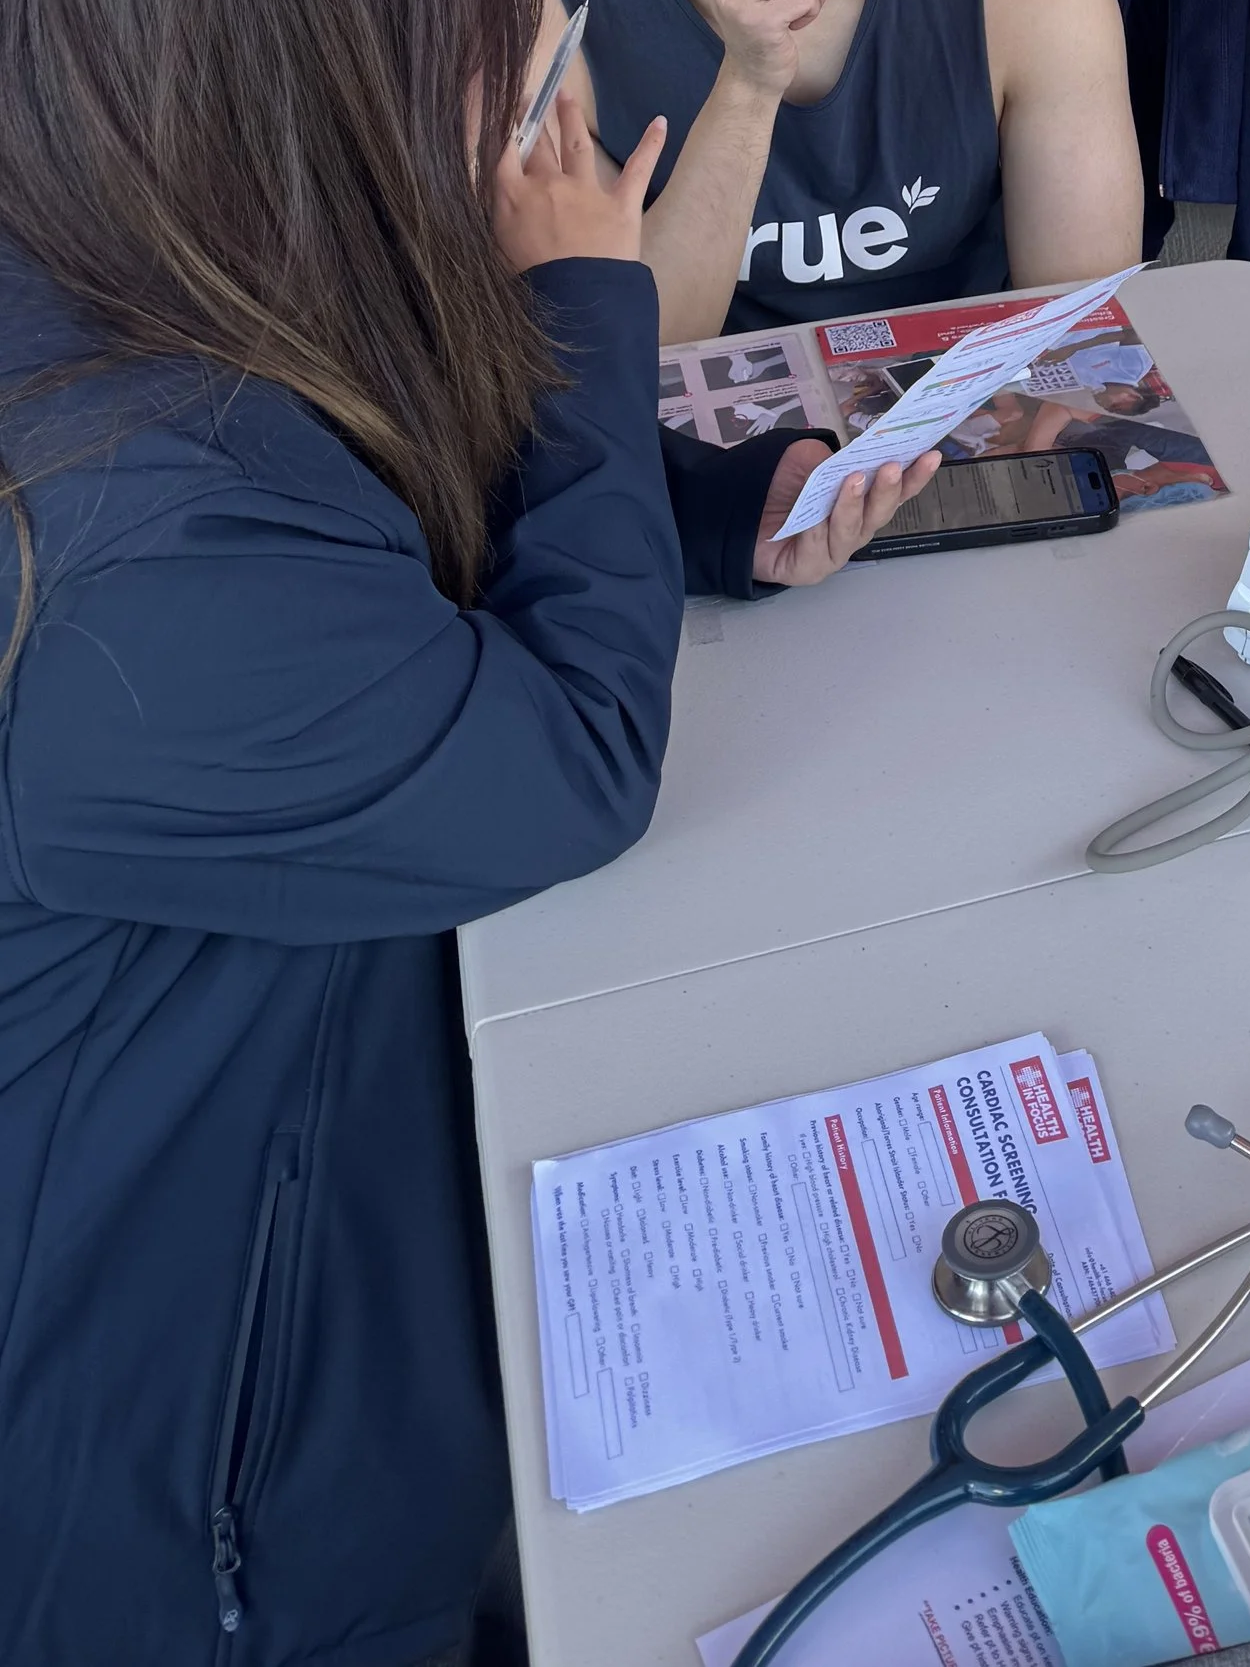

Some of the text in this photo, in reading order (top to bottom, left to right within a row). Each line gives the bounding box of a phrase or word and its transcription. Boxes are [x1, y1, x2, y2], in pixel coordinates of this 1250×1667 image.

[737, 205, 909, 284] rue
[909, 1090, 921, 1104] Age
[931, 1088, 960, 1155] Patient Information
[974, 1068, 1010, 1132] CARDIAC
[1020, 1087, 1049, 1139] IN FOCUS
[1031, 1083, 1062, 1136] HEALTH
[828, 1118, 850, 1172] Patient History
[953, 1075, 1005, 1188] CONSULTATION
[1080, 1105, 1105, 1158] HEALTH
[1051, 1268, 1061, 1276] of
[1008, 1554, 1029, 1587] Health
[1157, 1537, 1189, 1590] bacteria
[1011, 1593, 1046, 1655] Educate pt on
[1177, 1590, 1194, 1605] of
[960, 1618, 982, 1654] Give pt
[973, 1611, 1001, 1660] Refer pt to
[985, 1605, 1016, 1658] Emphasise
[998, 1599, 1035, 1664] Warning signs
